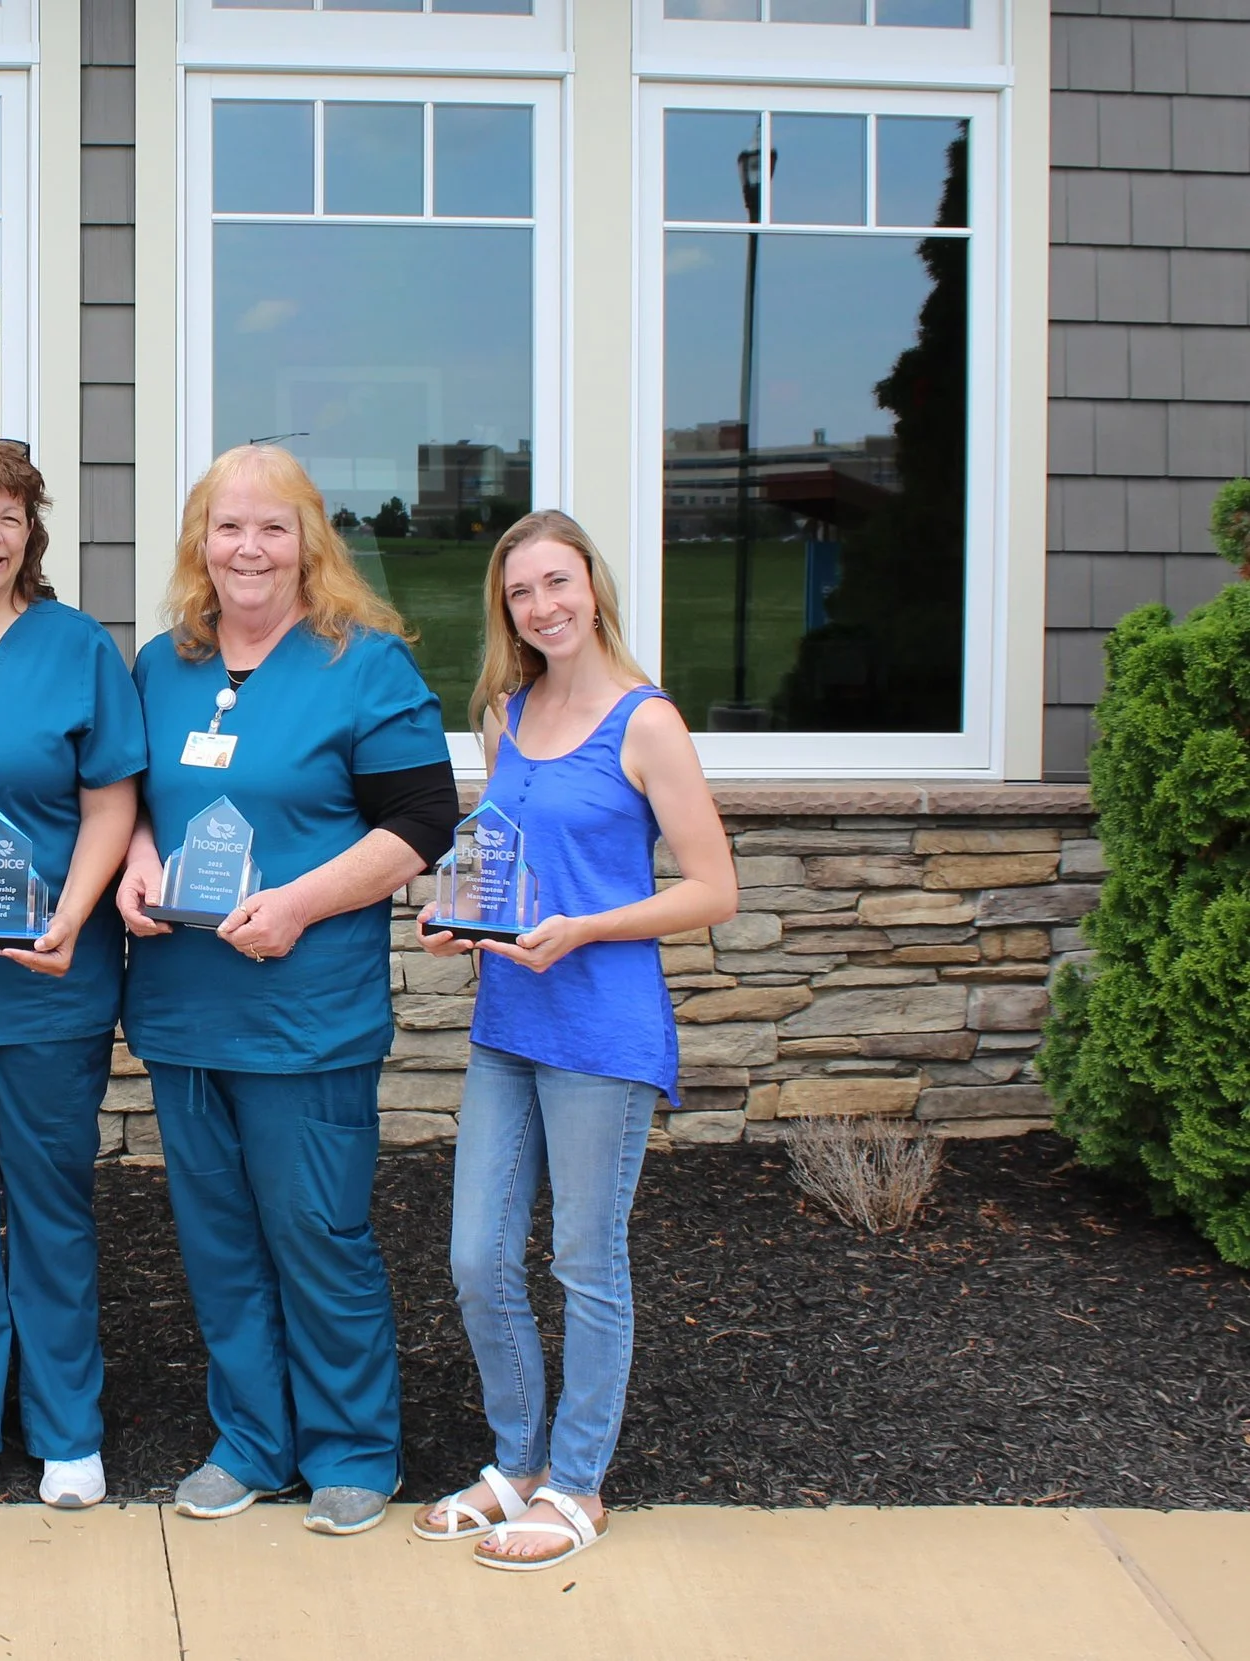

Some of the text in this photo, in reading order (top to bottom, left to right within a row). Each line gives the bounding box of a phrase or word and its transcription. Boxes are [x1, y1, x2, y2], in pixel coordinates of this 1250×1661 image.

[191, 836, 244, 853] hospice
[461, 844, 516, 861] hospice
[198, 868, 230, 877] Teamwork
[466, 875, 501, 885] Excellence
[190, 883, 233, 894] Collaboration
[472, 885, 503, 894] Symptom
[466, 893, 508, 902] Management
[477, 902, 498, 910] Award
